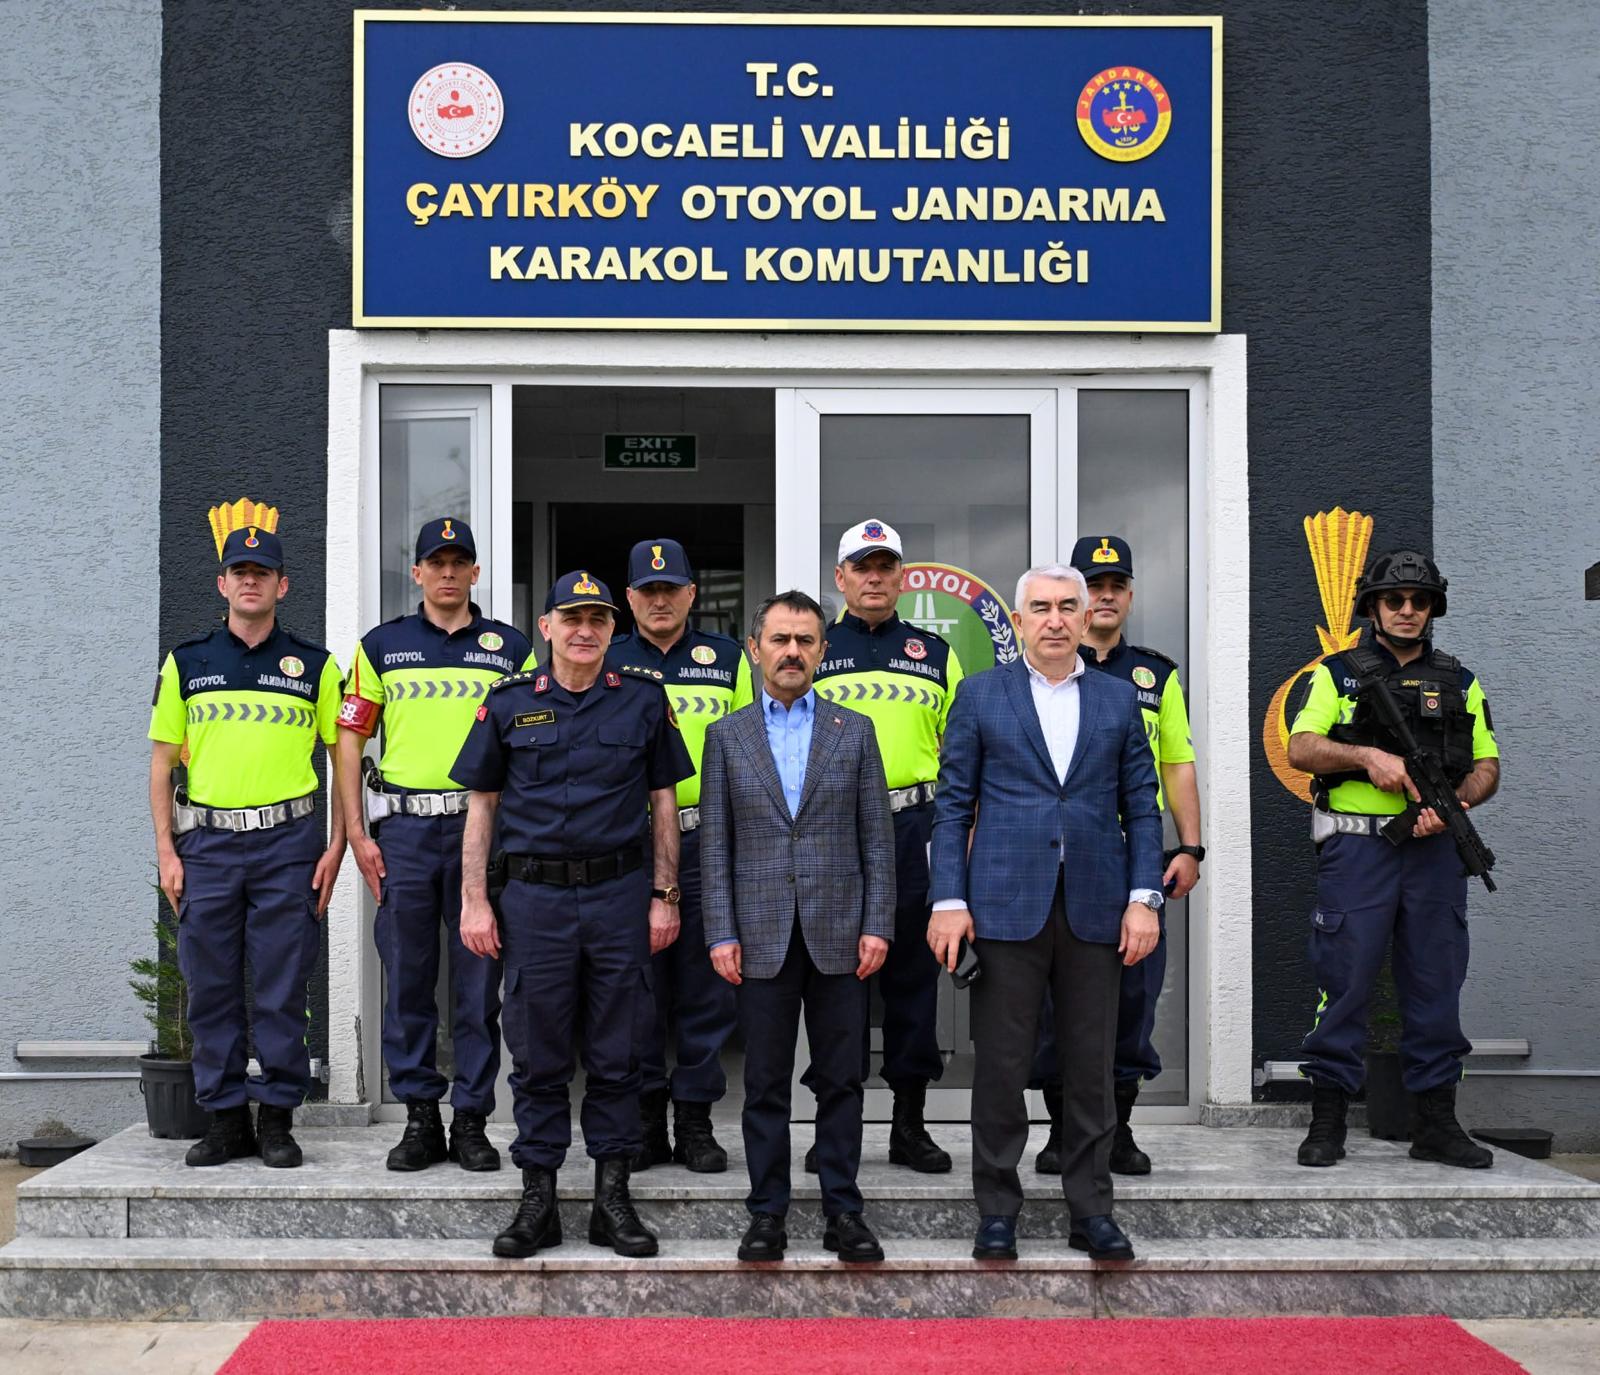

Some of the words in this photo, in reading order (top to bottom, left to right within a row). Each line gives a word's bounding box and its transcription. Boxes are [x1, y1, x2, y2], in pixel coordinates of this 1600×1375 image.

[746, 62, 834, 97] T.C.
[1081, 68, 1165, 109] JANDARMA
[570, 116, 784, 159] KOCAELİ
[801, 116, 1010, 161] VALİLİĞİ
[406, 176, 660, 227] ÇAYIRKÖY
[681, 185, 877, 221] OTOYOL
[892, 187, 1166, 222] JANDARMA
[490, 246, 728, 282] KARAKOL
[745, 241, 1090, 284] KOMUTANLIĞI
[624, 437, 677, 449] EXIT
[619, 452, 682, 466] ÇIKIŞ
[901, 570, 972, 601] OYOL
[383, 651, 426, 666] OTOYOL
[463, 651, 515, 674] JANDARMASI
[888, 658, 940, 680] JANDARMASI
[188, 674, 228, 691] OTOYOL
[257, 673, 313, 696] JANDARMASI
[678, 667, 732, 684] JANDARMASI
[1343, 676, 1360, 689] OT
